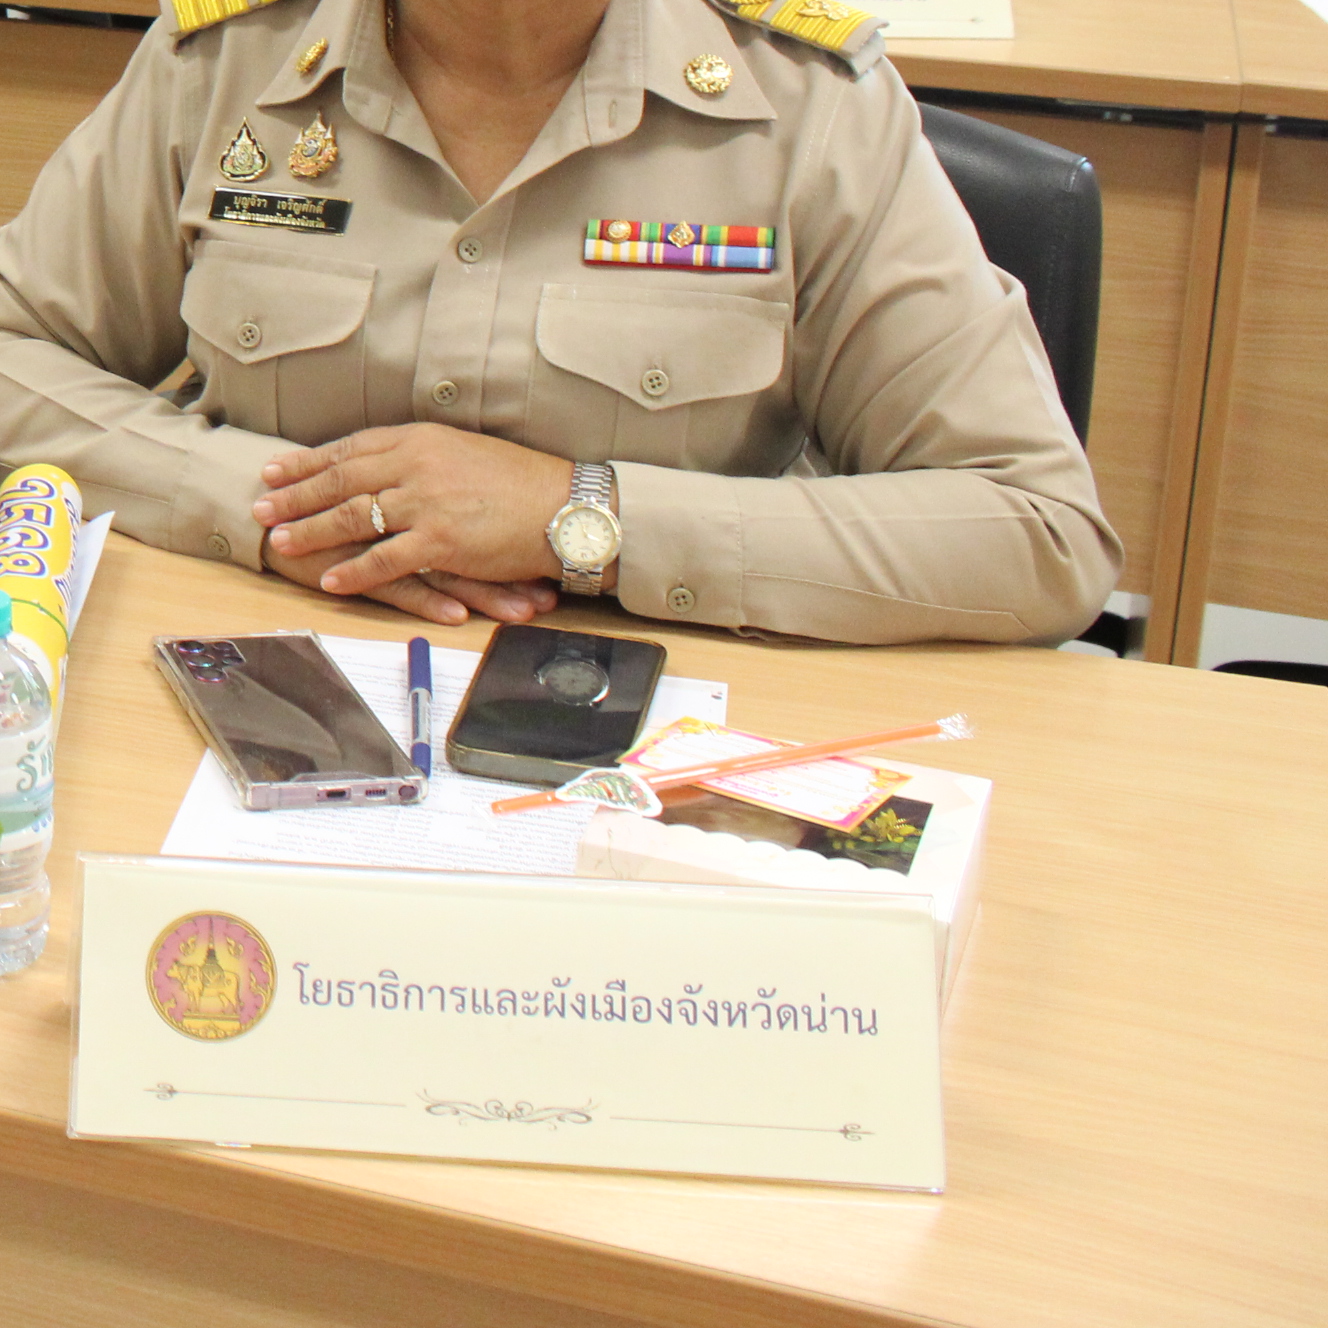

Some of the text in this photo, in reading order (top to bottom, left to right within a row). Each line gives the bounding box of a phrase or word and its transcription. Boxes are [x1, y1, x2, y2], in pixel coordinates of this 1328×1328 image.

[292, 962, 880, 1037] โยธาธิการและผังเมืองจังหวัดน่าน
